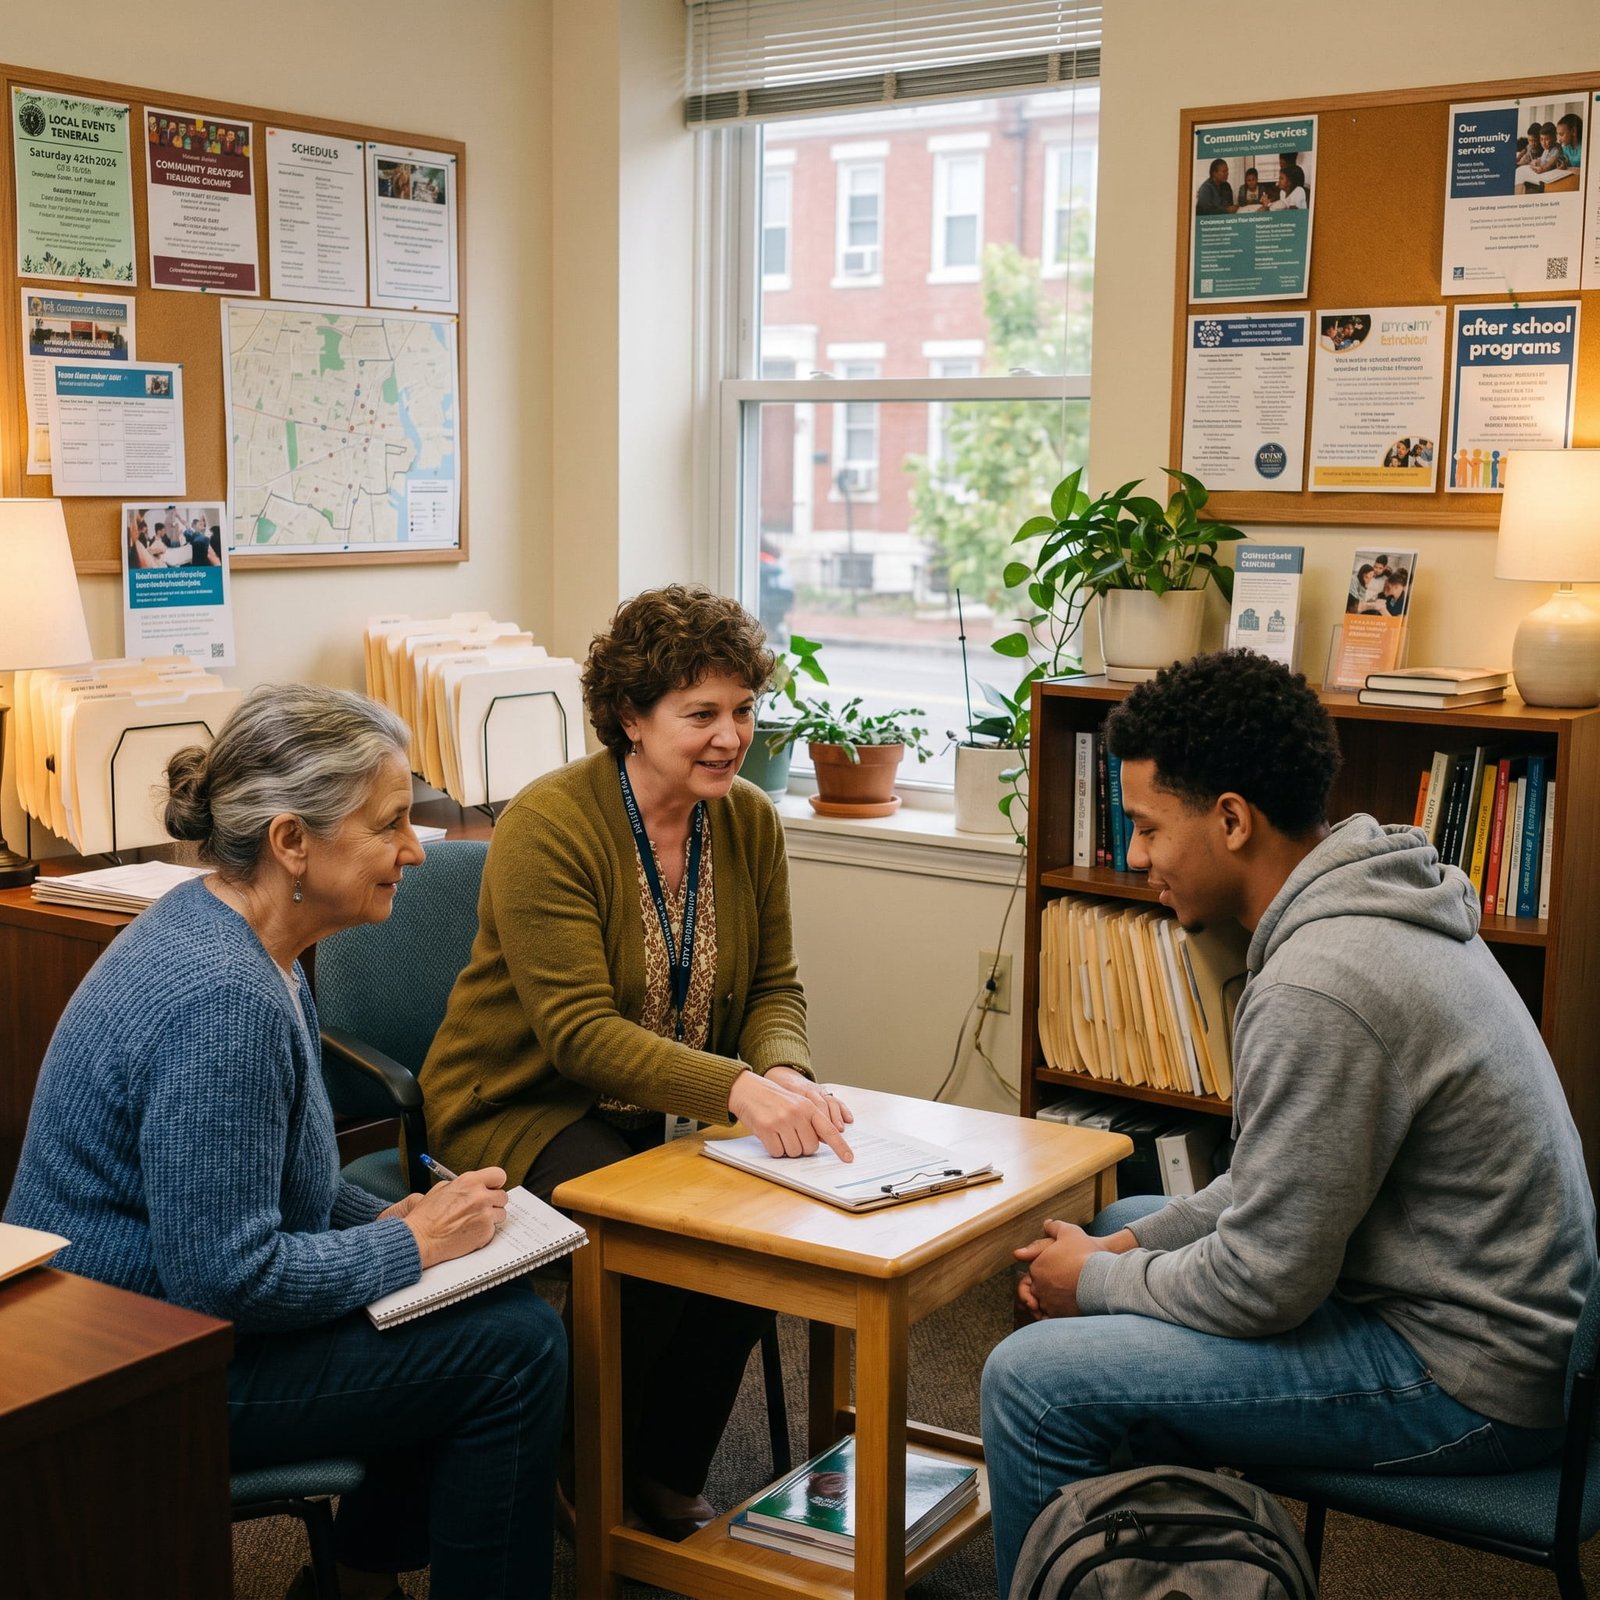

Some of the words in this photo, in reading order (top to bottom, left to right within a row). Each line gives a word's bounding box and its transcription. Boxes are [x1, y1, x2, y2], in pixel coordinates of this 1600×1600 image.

[49, 114, 79, 128] LOCAL
[81, 119, 116, 133] EVENTS
[1458, 124, 1477, 133] Our
[51, 127, 100, 143] TENERALS
[1203, 131, 1261, 144] Community
[1263, 127, 1308, 139] Services
[1458, 131, 1511, 143] community
[29, 147, 72, 164] Saturday
[1457, 145, 1496, 155] services
[155, 159, 206, 174] COMMUNITY
[1462, 317, 1508, 336] after
[1512, 315, 1571, 335] school
[1469, 341, 1561, 361] programs
